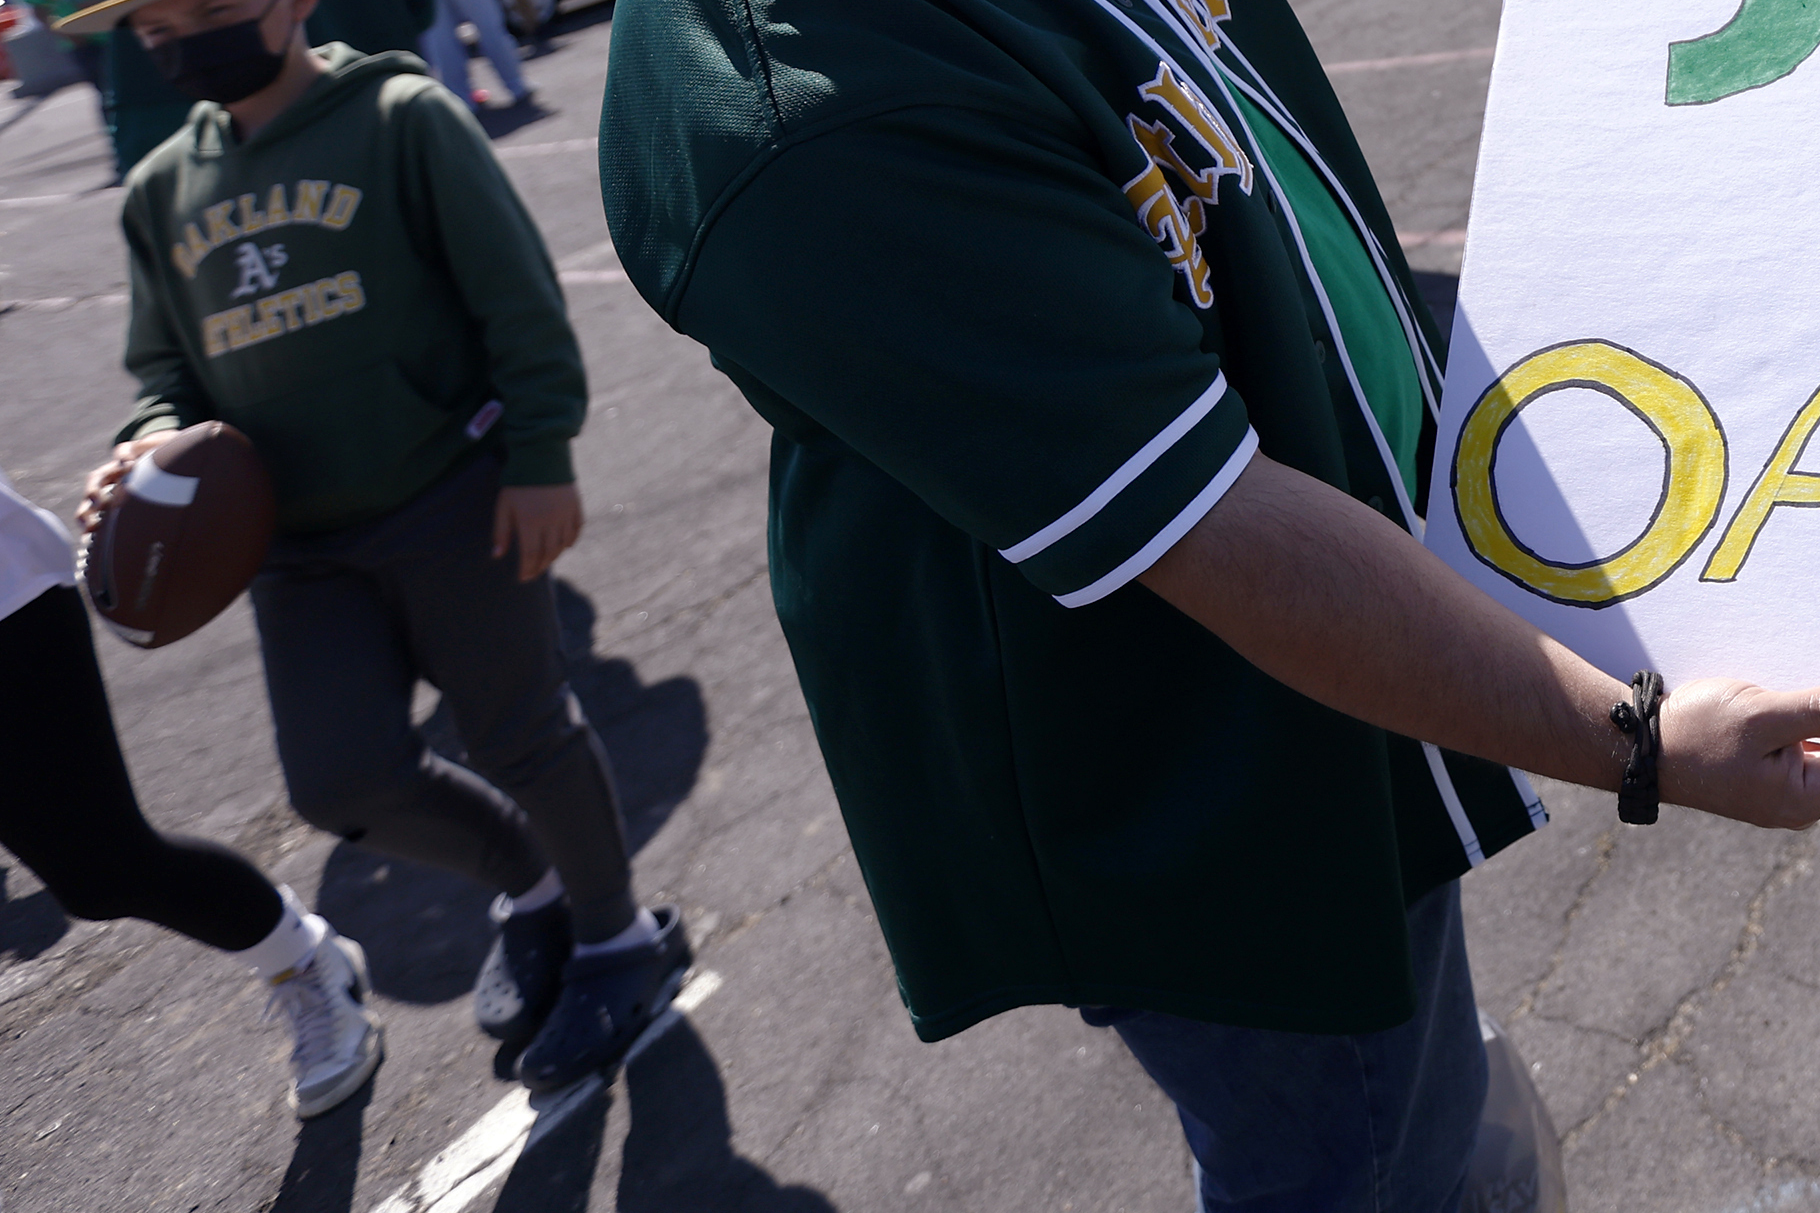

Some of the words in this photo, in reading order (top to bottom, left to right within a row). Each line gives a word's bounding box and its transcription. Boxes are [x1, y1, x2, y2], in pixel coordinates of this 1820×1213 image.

[171, 178, 364, 280] OAKLAND
[229, 241, 289, 299] A's
[201, 269, 367, 358] THLETICS
